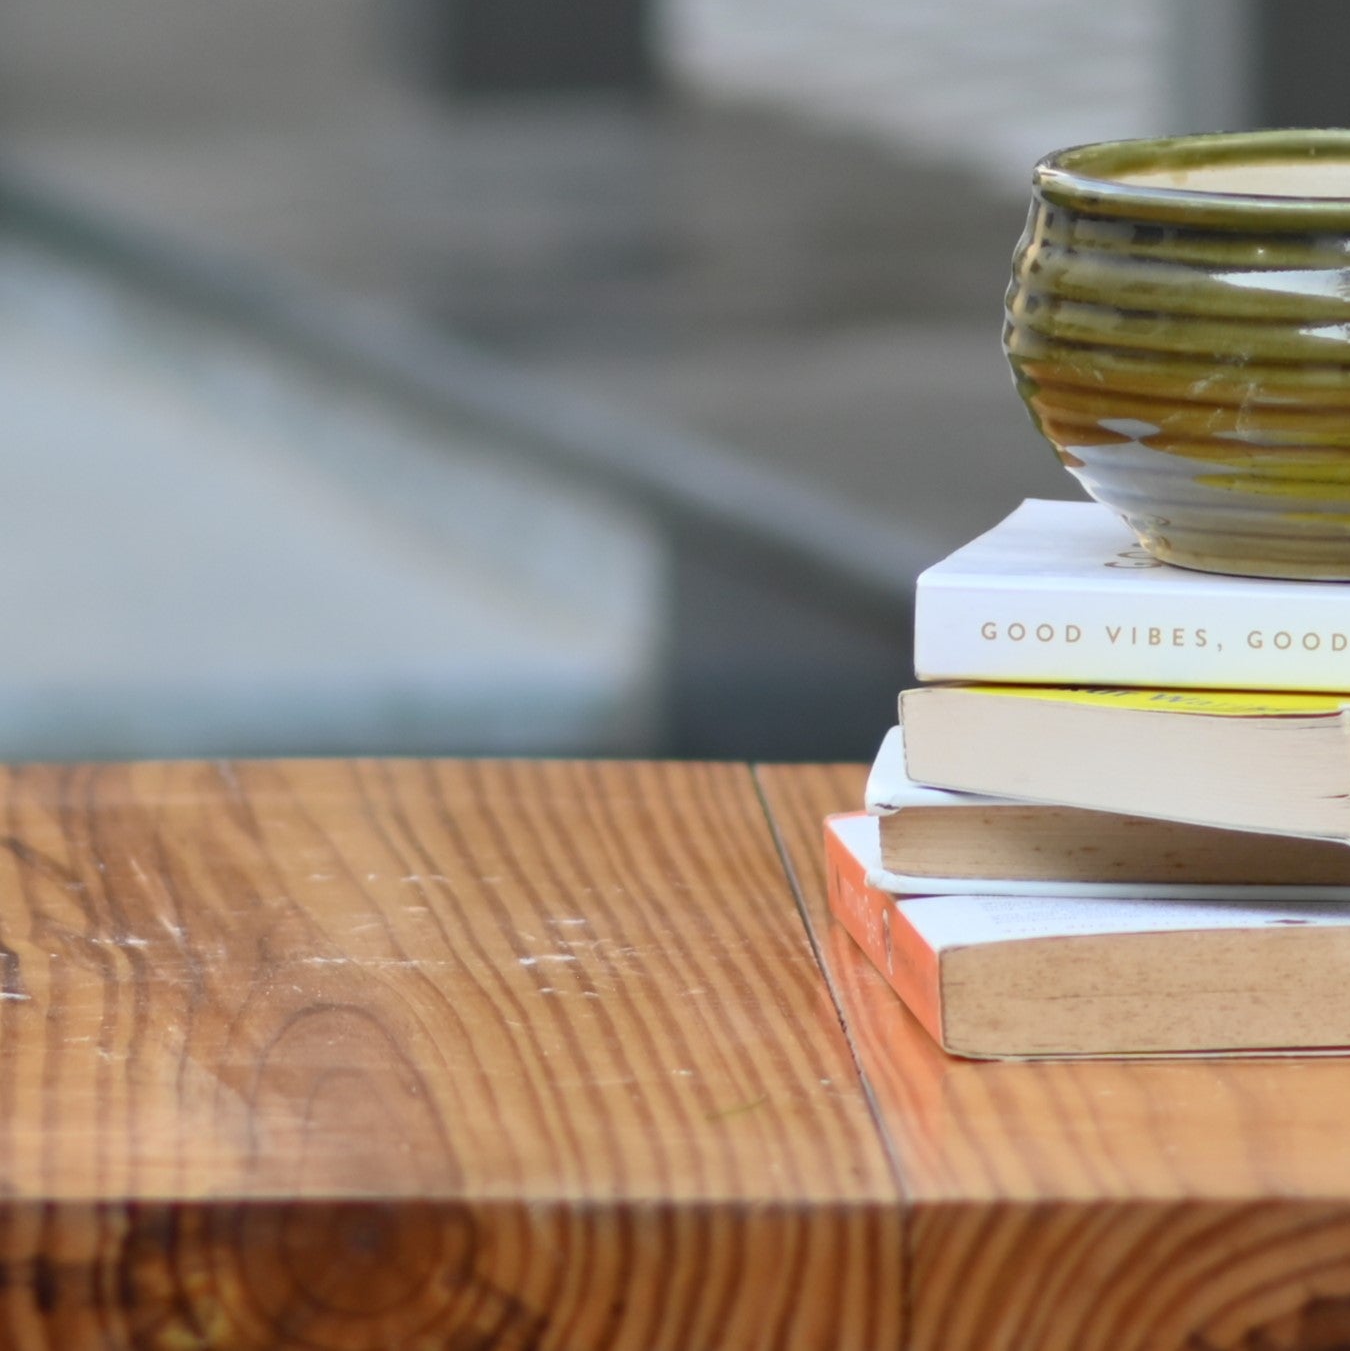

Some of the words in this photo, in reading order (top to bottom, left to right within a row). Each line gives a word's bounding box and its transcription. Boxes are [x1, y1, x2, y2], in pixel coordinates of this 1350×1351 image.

[980, 621, 1082, 644] GOOD
[1104, 624, 1223, 652] VIBES,
[1246, 630, 1348, 652] GOOD
